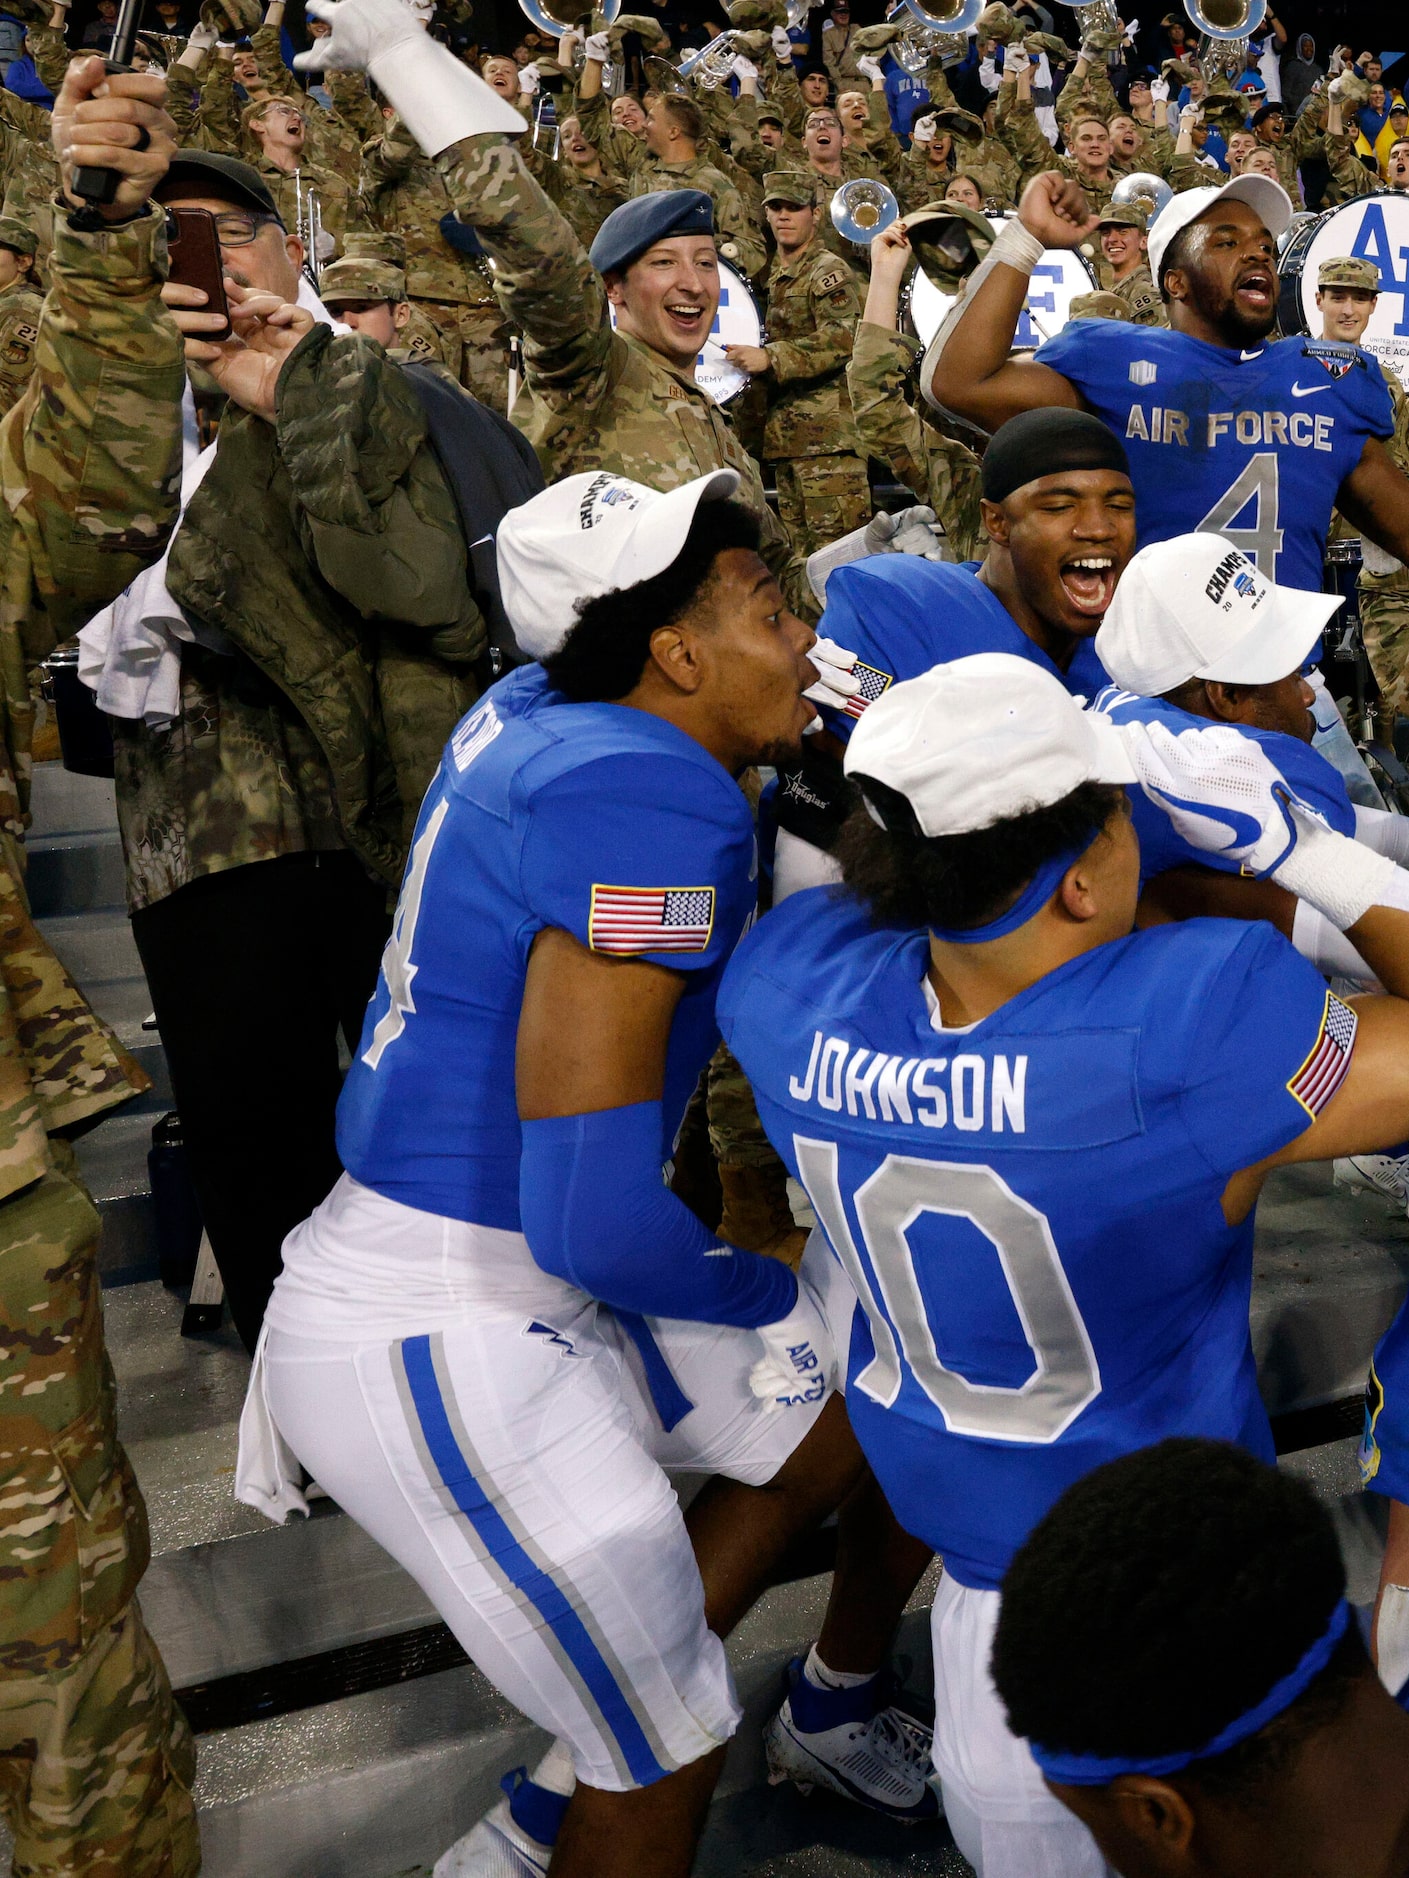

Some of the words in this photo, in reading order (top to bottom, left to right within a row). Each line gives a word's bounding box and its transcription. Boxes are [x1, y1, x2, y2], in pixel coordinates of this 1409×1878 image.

[822, 273, 839, 288] 27
[1010, 264, 1064, 347] F
[1134, 295, 1151, 309] 26
[412, 336, 432, 353] 27
[1360, 343, 1391, 356] FORCE
[1369, 336, 1391, 344] UNITED
[697, 375, 723, 383] DEMY
[714, 387, 730, 400] RPS
[1125, 404, 1190, 447] AIR
[1207, 411, 1335, 452] FORCE
[1193, 452, 1286, 585] 4
[1205, 551, 1248, 605] CHAMPS
[1222, 601, 1233, 613] 20
[790, 781, 826, 810] Douglas
[789, 1030, 1029, 1134] JOHNSON
[792, 1132, 1103, 1445] 10
[785, 1340, 819, 1375] AIR
